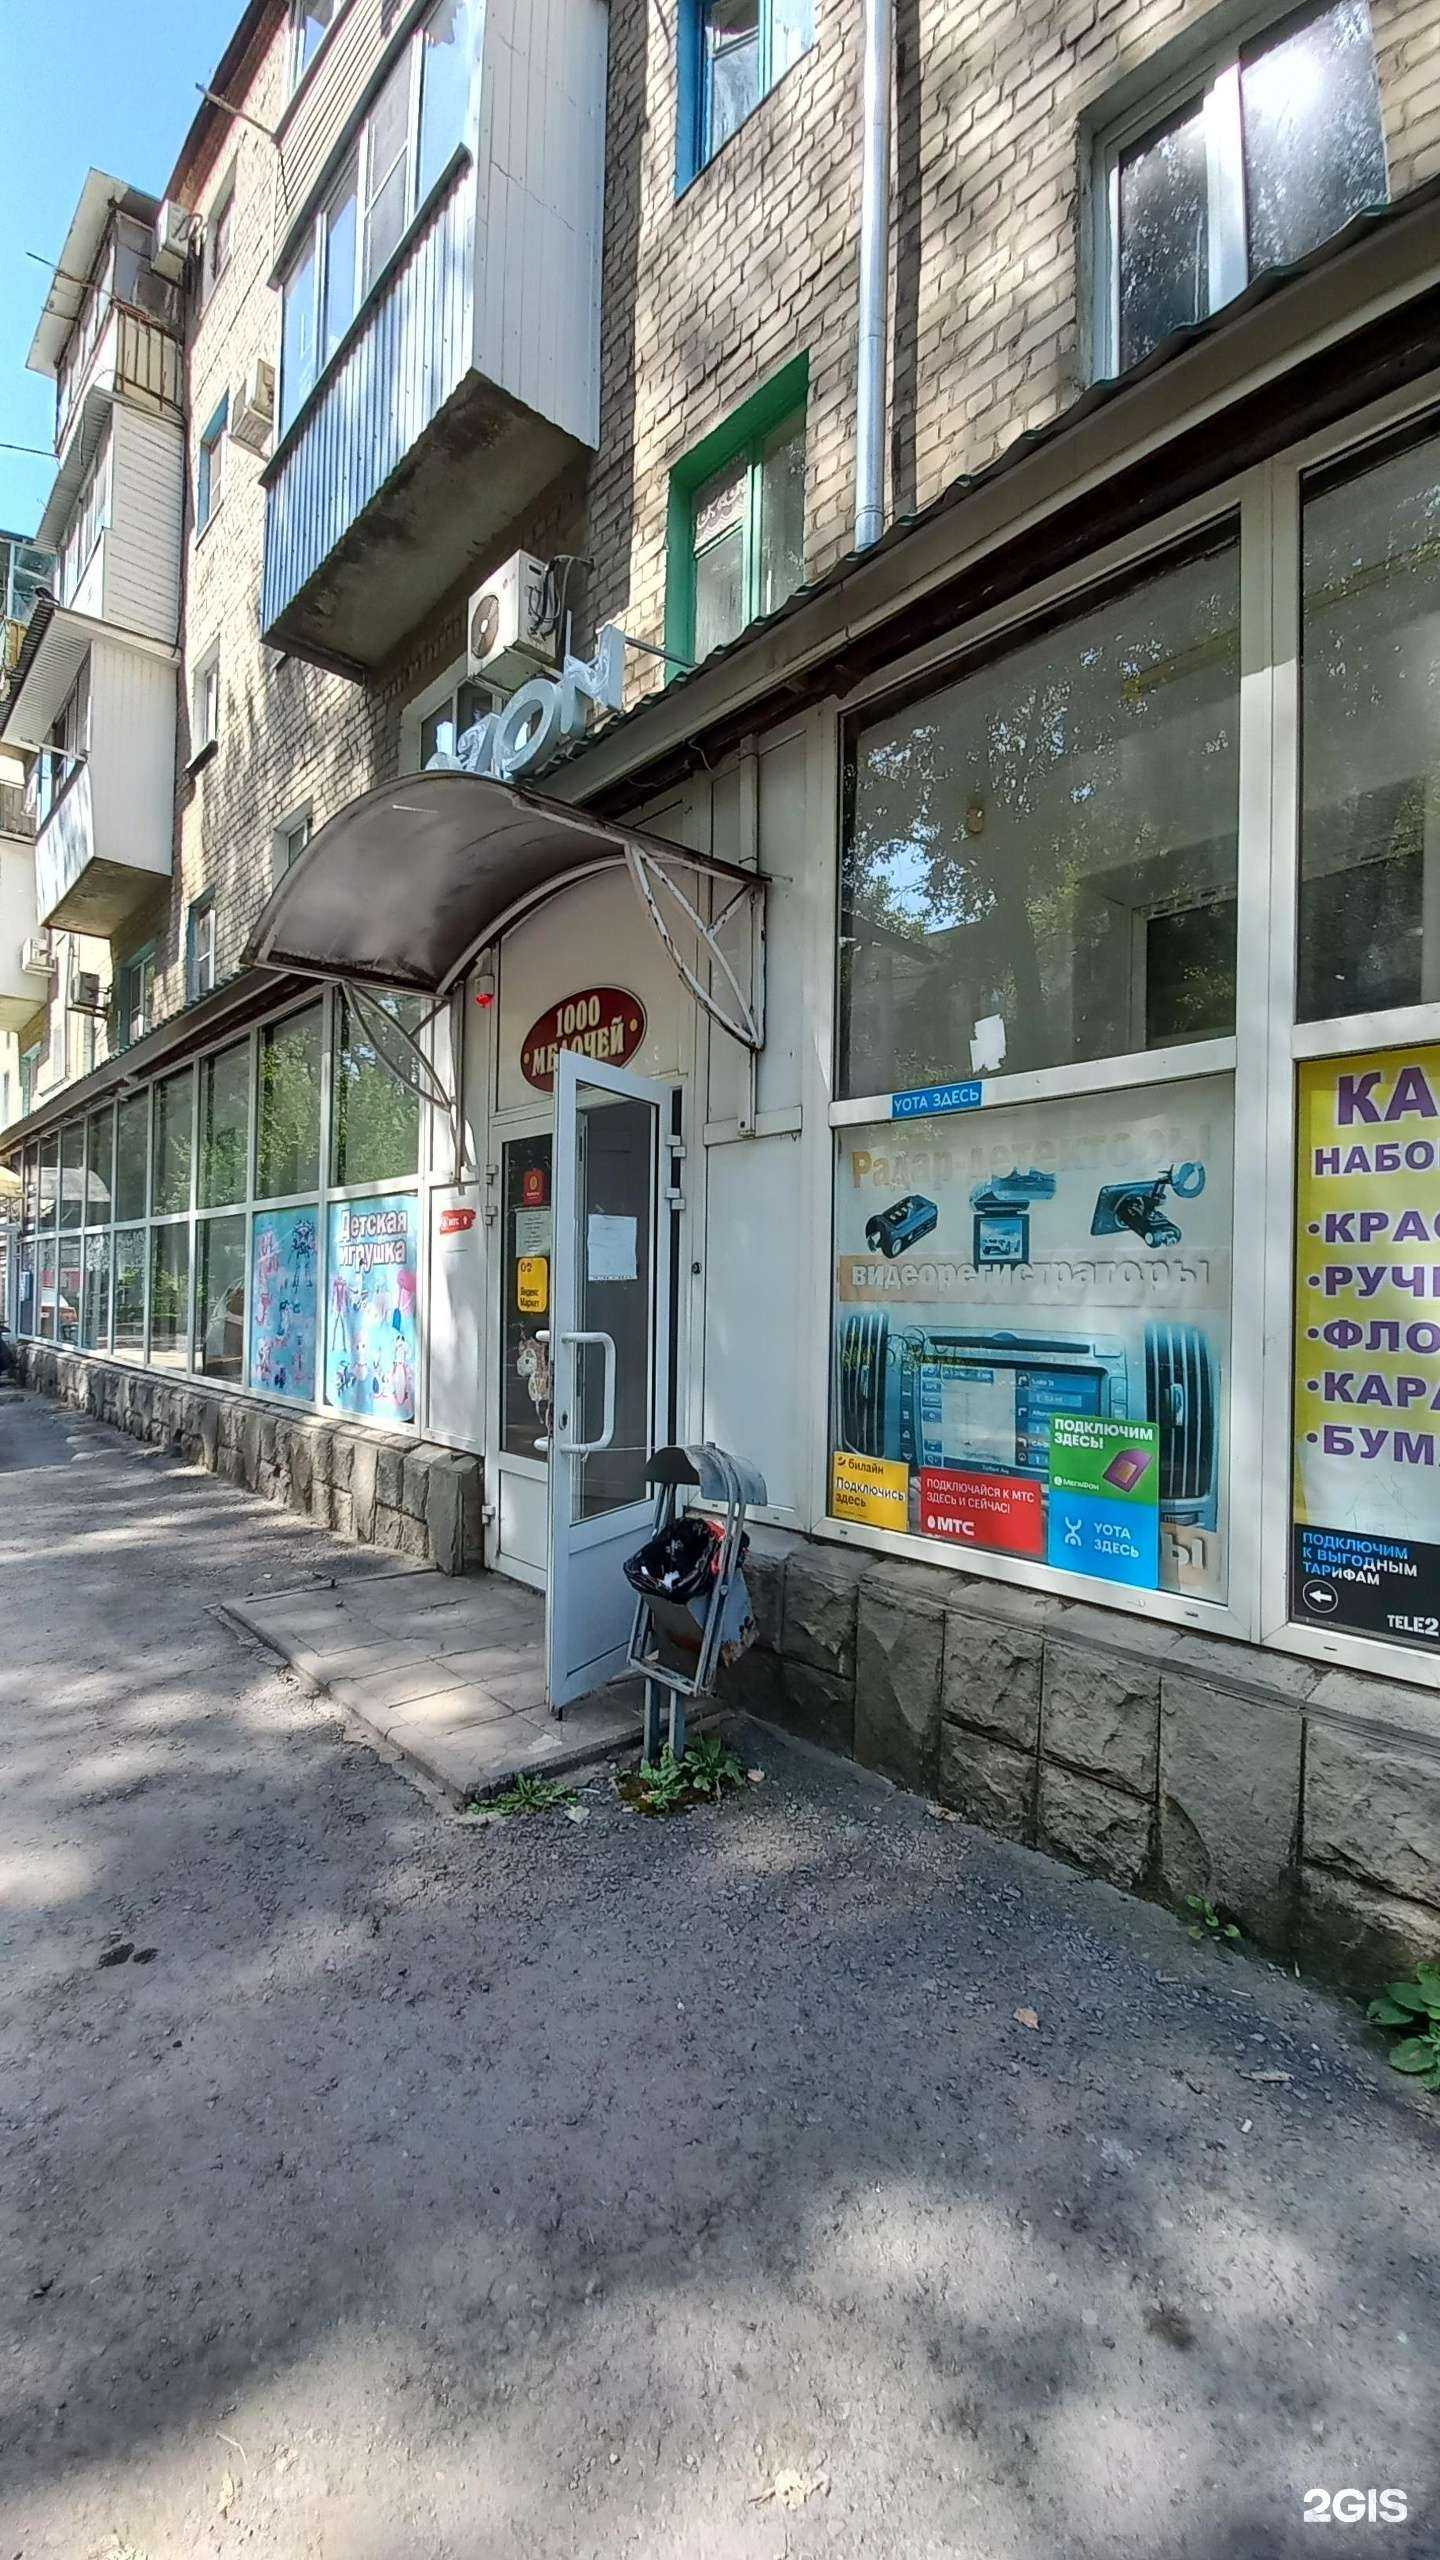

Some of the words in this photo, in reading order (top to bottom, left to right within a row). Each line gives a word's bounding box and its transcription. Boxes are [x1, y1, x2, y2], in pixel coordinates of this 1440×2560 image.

[556, 995, 600, 1037] 1000
[894, 1096, 928, 1112] YOTA
[933, 1088, 979, 1107] ЗДЕСЬ
[340, 1209, 408, 1243] Детская
[1325, 1210, 1440, 1243] КРА
[339, 1240, 407, 1274] игрушка
[1323, 1371, 1440, 1411] КАР
[1054, 1418, 1153, 1441] ПОДКЛЮЧИМ
[1054, 1432, 1104, 1449] ЗДЕСЬ!
[1323, 1424, 1440, 1467] БУМ
[848, 1459, 884, 1475] билайн
[836, 1477, 905, 1501] Подключись
[836, 1493, 867, 1508] здесь
[926, 1478, 1001, 1498] ПОДКЛЮЧАЙСЯ
[1002, 1489, 1010, 1500] К
[1012, 1491, 1035, 1503] МТС
[926, 1491, 957, 1505] ЗДЕСЬ
[959, 1496, 966, 1506] И
[968, 1498, 1011, 1514] СЕЙЧАС!
[937, 1516, 975, 1536] МТС
[1094, 1522, 1132, 1540] YOTA
[1094, 1539, 1141, 1558] ЗДЕСЬ
[1302, 1532, 1408, 1560] ПОДКЛЮЧИМ
[1302, 1547, 1312, 1558] К
[1317, 1549, 1418, 1577] ВЫГОДНЫМ
[1302, 1561, 1380, 1586] ТАРИФАМ
[1387, 1614, 1440, 1637] TELE2
